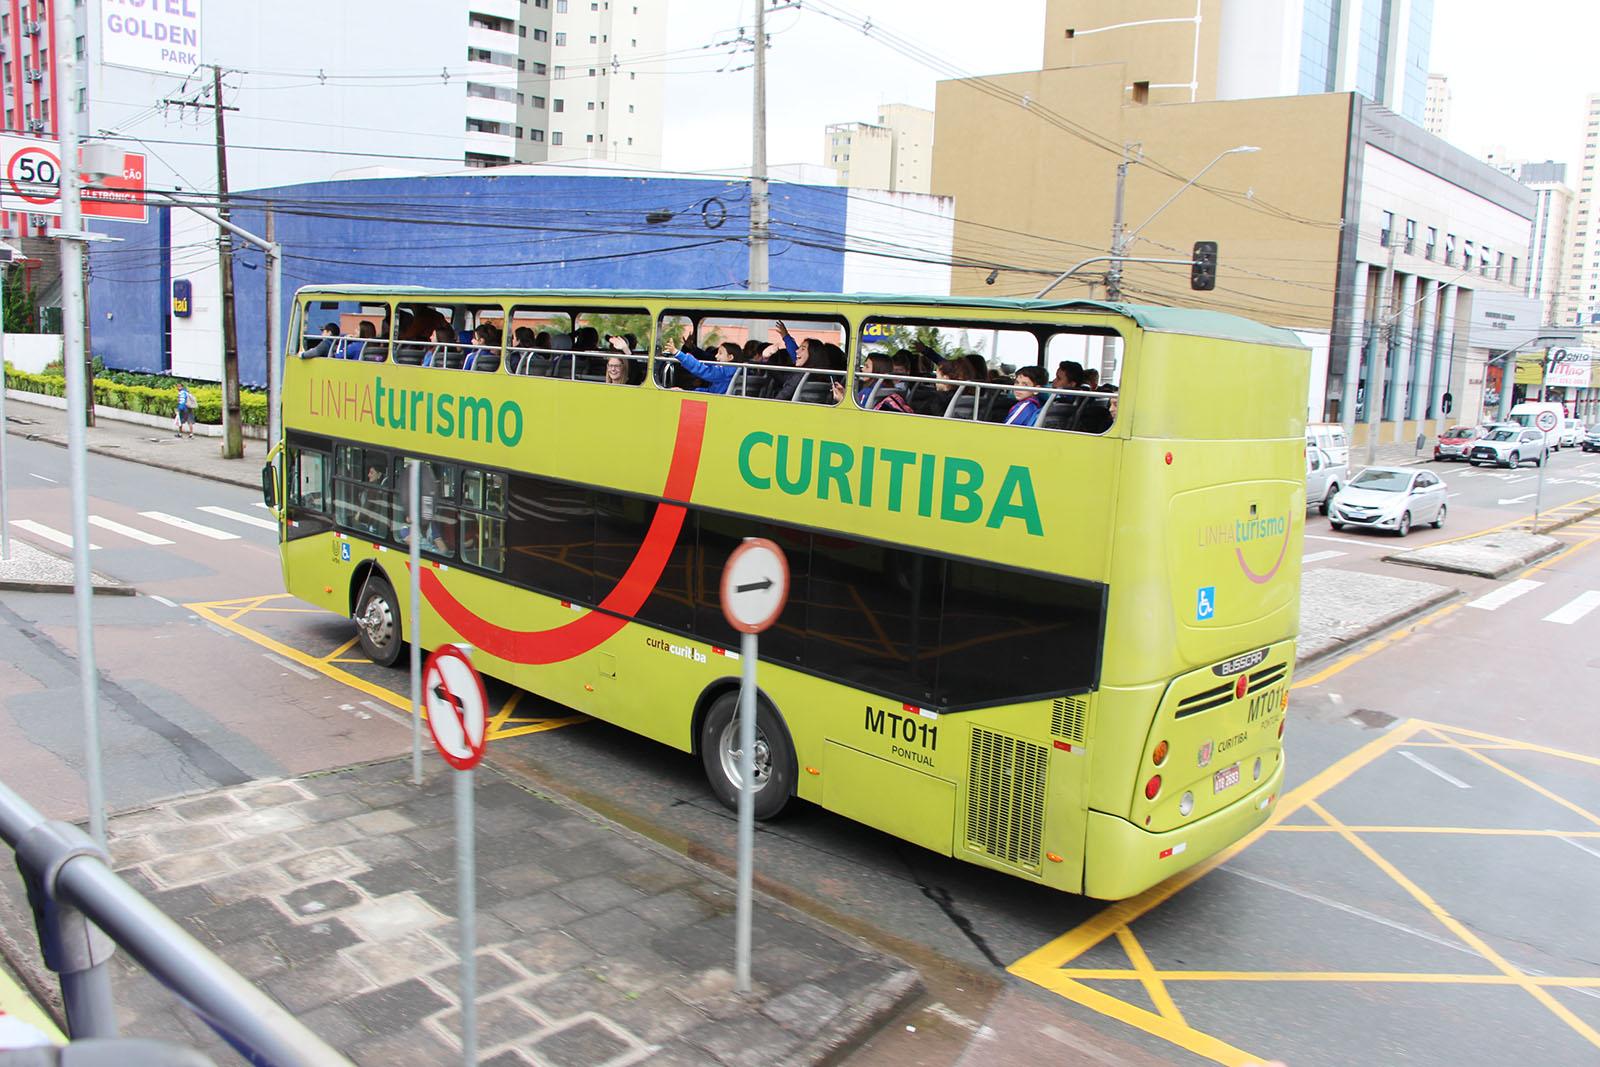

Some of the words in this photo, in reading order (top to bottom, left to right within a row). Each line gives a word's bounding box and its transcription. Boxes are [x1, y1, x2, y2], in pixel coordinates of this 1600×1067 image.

[107, 14, 196, 47] GOLDEN
[161, 48, 196, 66] PARK
[20, 157, 55, 183] 50
[738, 431, 1045, 537] CURITIBA
[865, 705, 938, 751] MT011
[891, 744, 935, 768] PONTUAL
